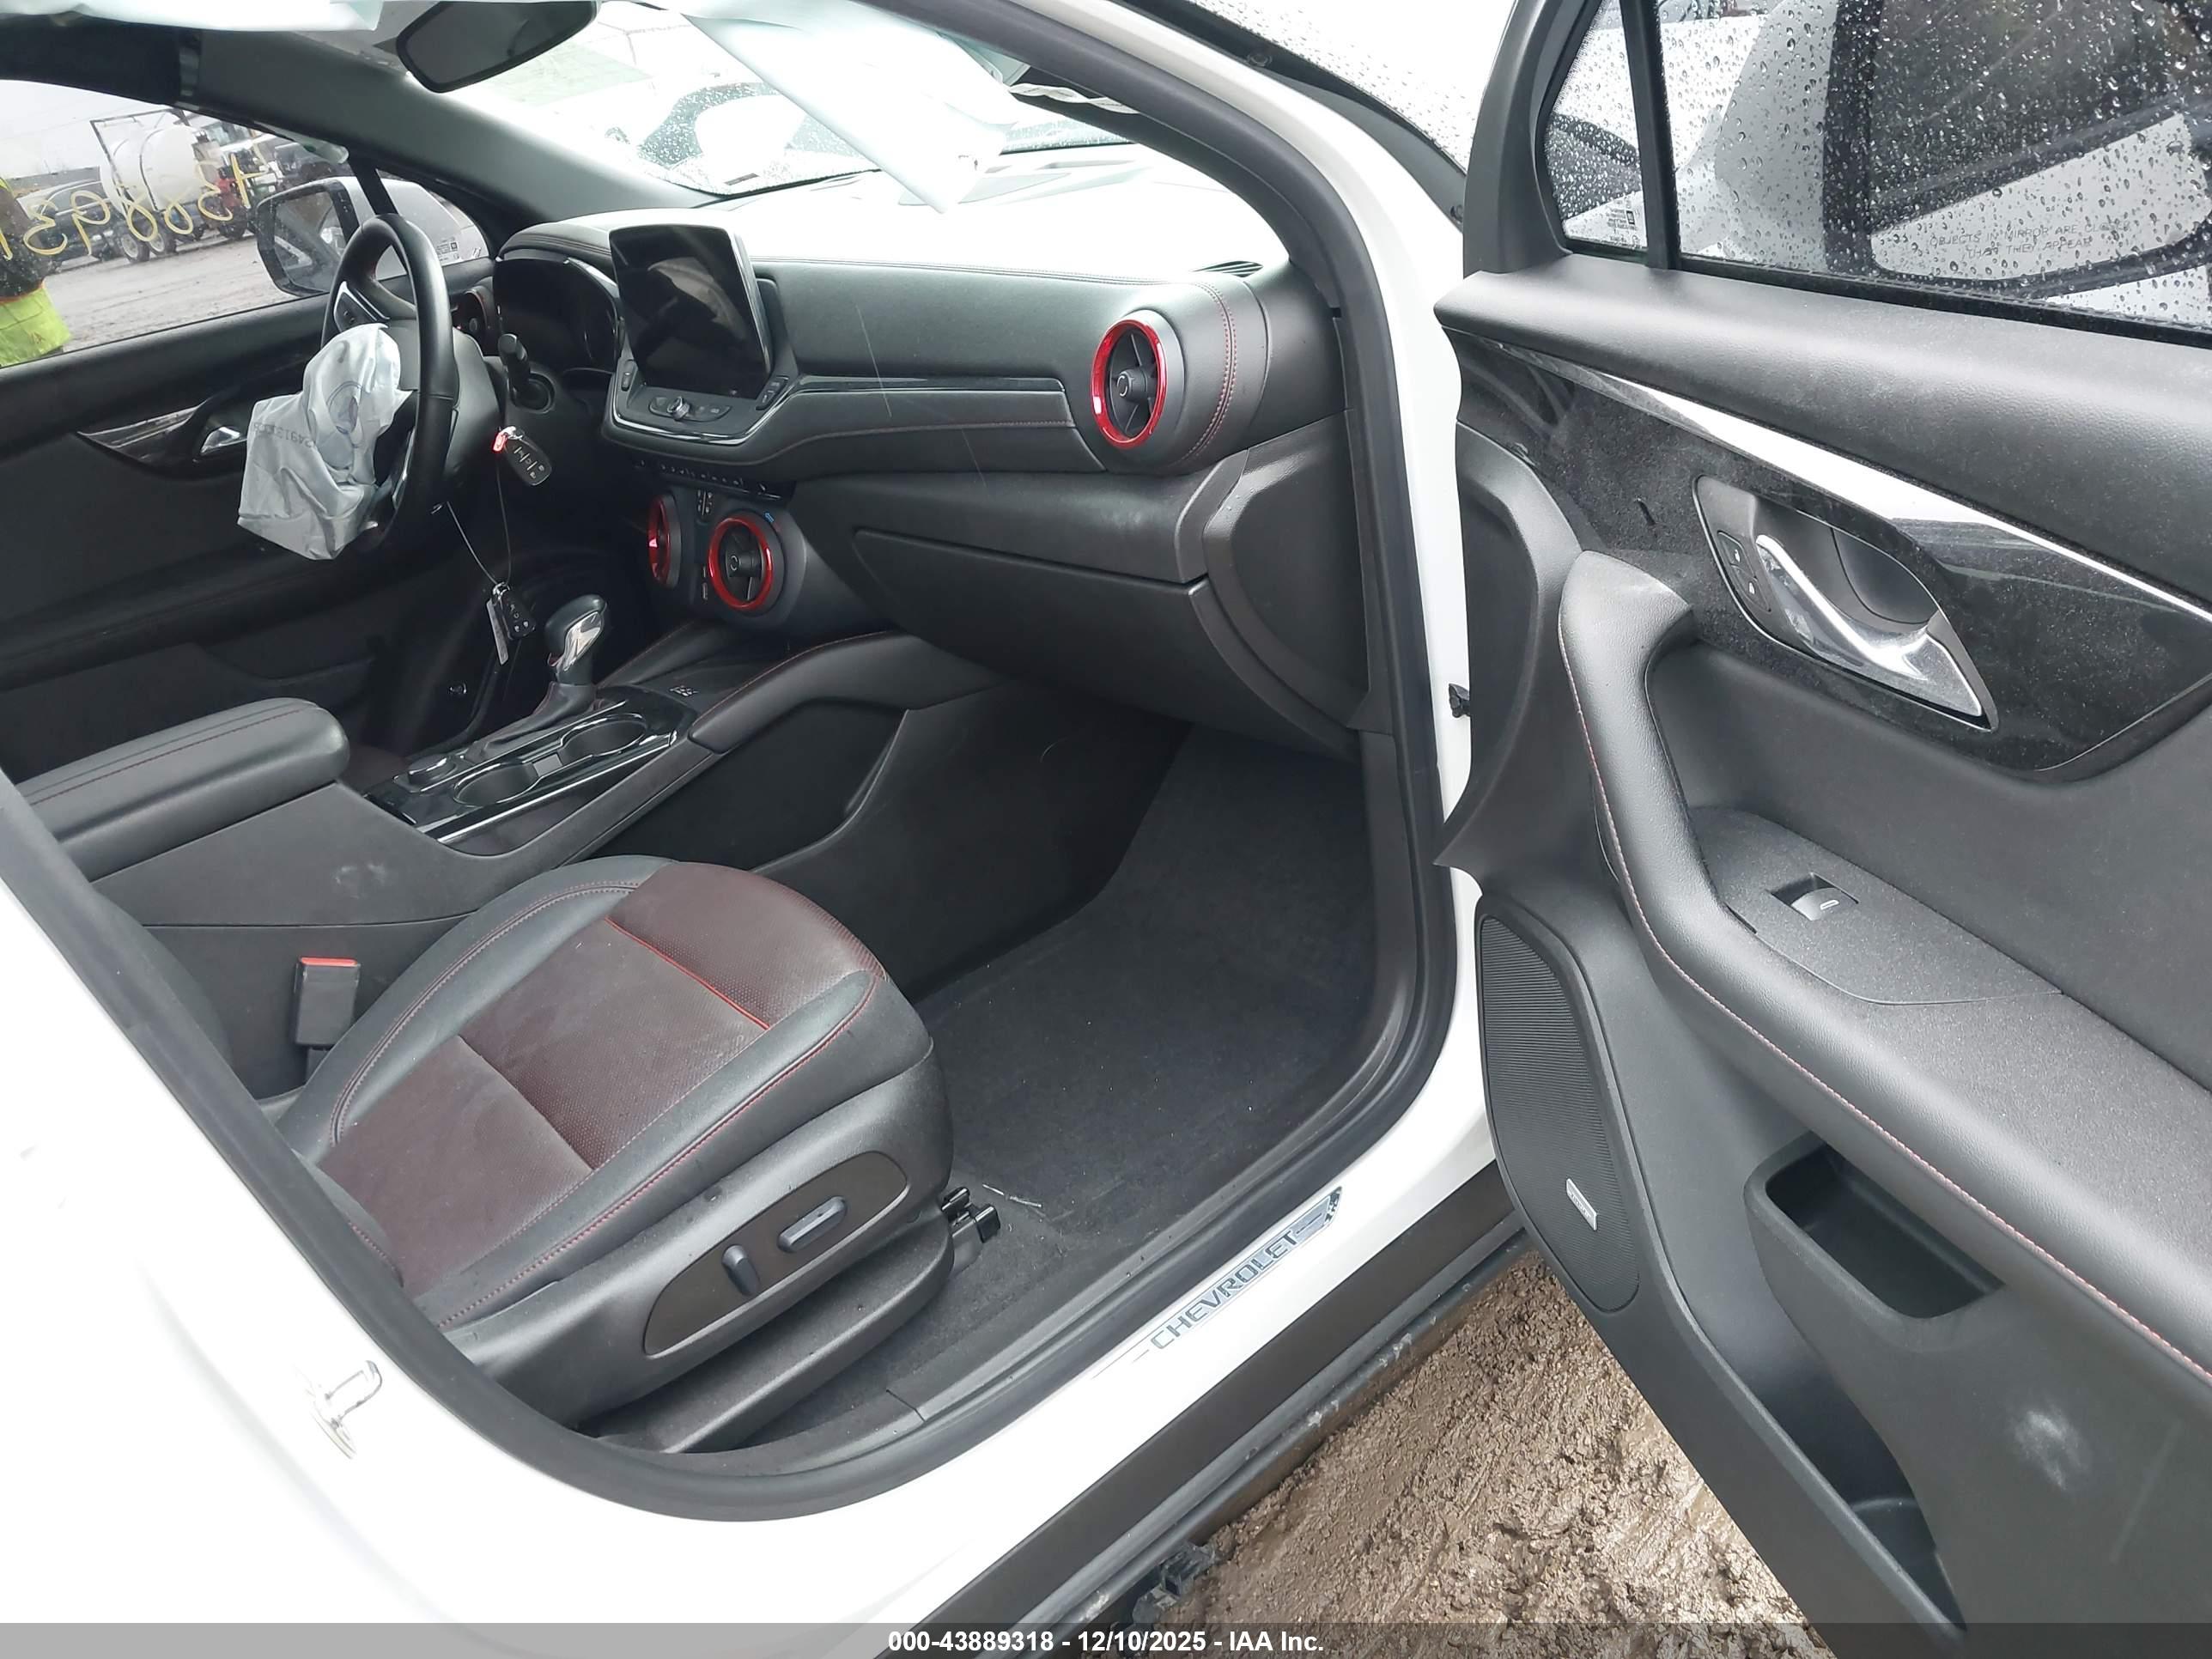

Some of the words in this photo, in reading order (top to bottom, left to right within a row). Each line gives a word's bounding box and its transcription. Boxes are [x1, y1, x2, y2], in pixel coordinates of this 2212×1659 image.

[1930, 233, 1980, 246] OBJECTS
[2005, 227, 2050, 241] MIRROR
[2055, 224, 2079, 235] ARE
[2006, 244, 2036, 254] THEY
[1151, 1231, 1297, 1349] CHEVROLET
